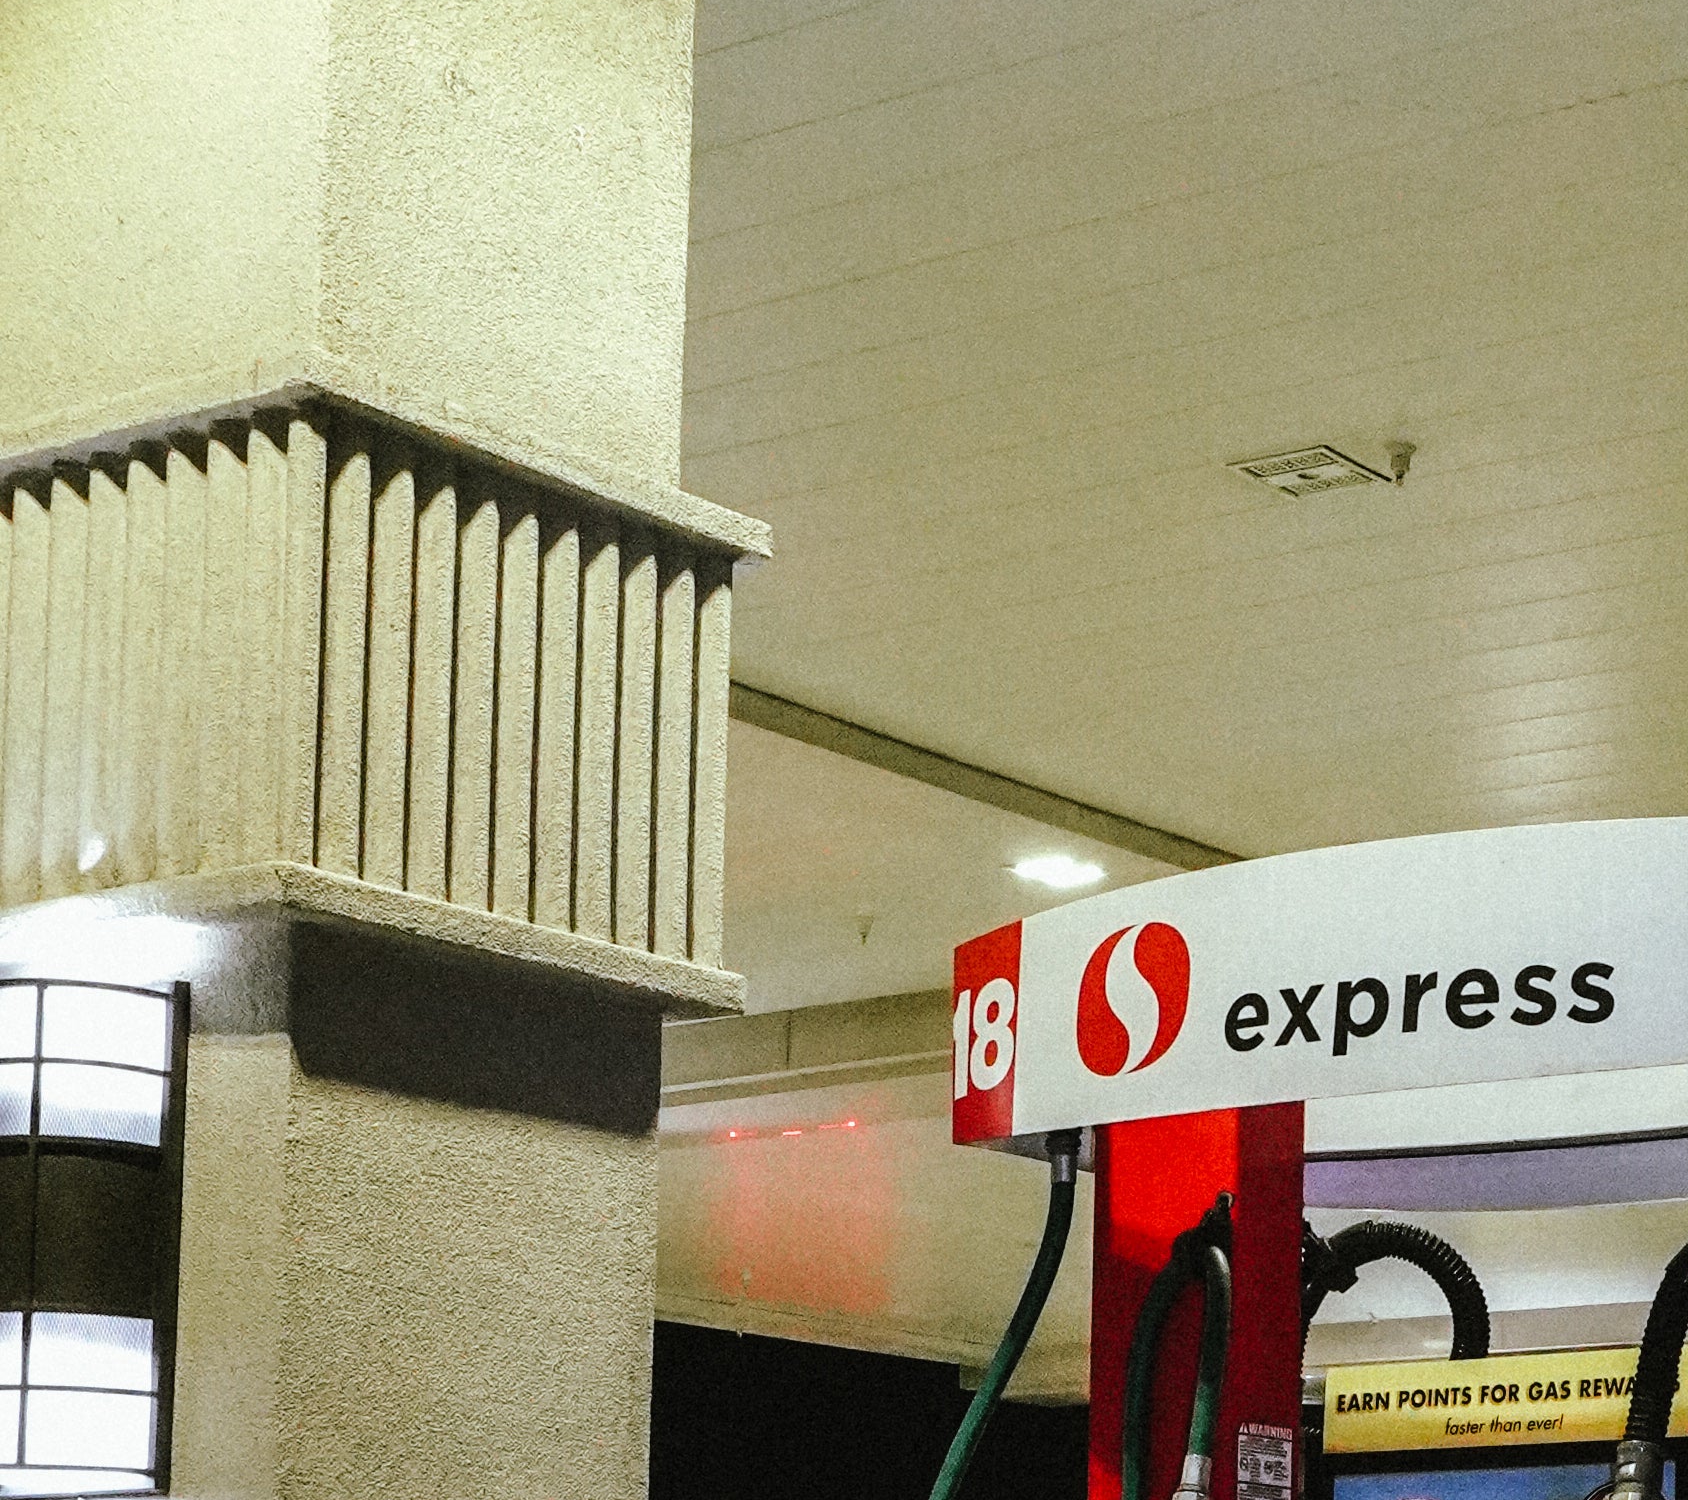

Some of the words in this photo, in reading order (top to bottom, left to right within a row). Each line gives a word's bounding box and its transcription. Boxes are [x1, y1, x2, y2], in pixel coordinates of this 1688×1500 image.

[952, 977, 1016, 1101] 18
[1224, 961, 1616, 1057] express
[1335, 1391, 1390, 1414] EARN
[1399, 1384, 1473, 1409] POINTS
[1480, 1381, 1521, 1404] FOR
[1528, 1379, 1572, 1402] GAS
[1579, 1375, 1680, 1399] REWA
[1444, 1418, 1484, 1437] faster
[1489, 1416, 1522, 1434] than
[1526, 1414, 1564, 1432] ever!
